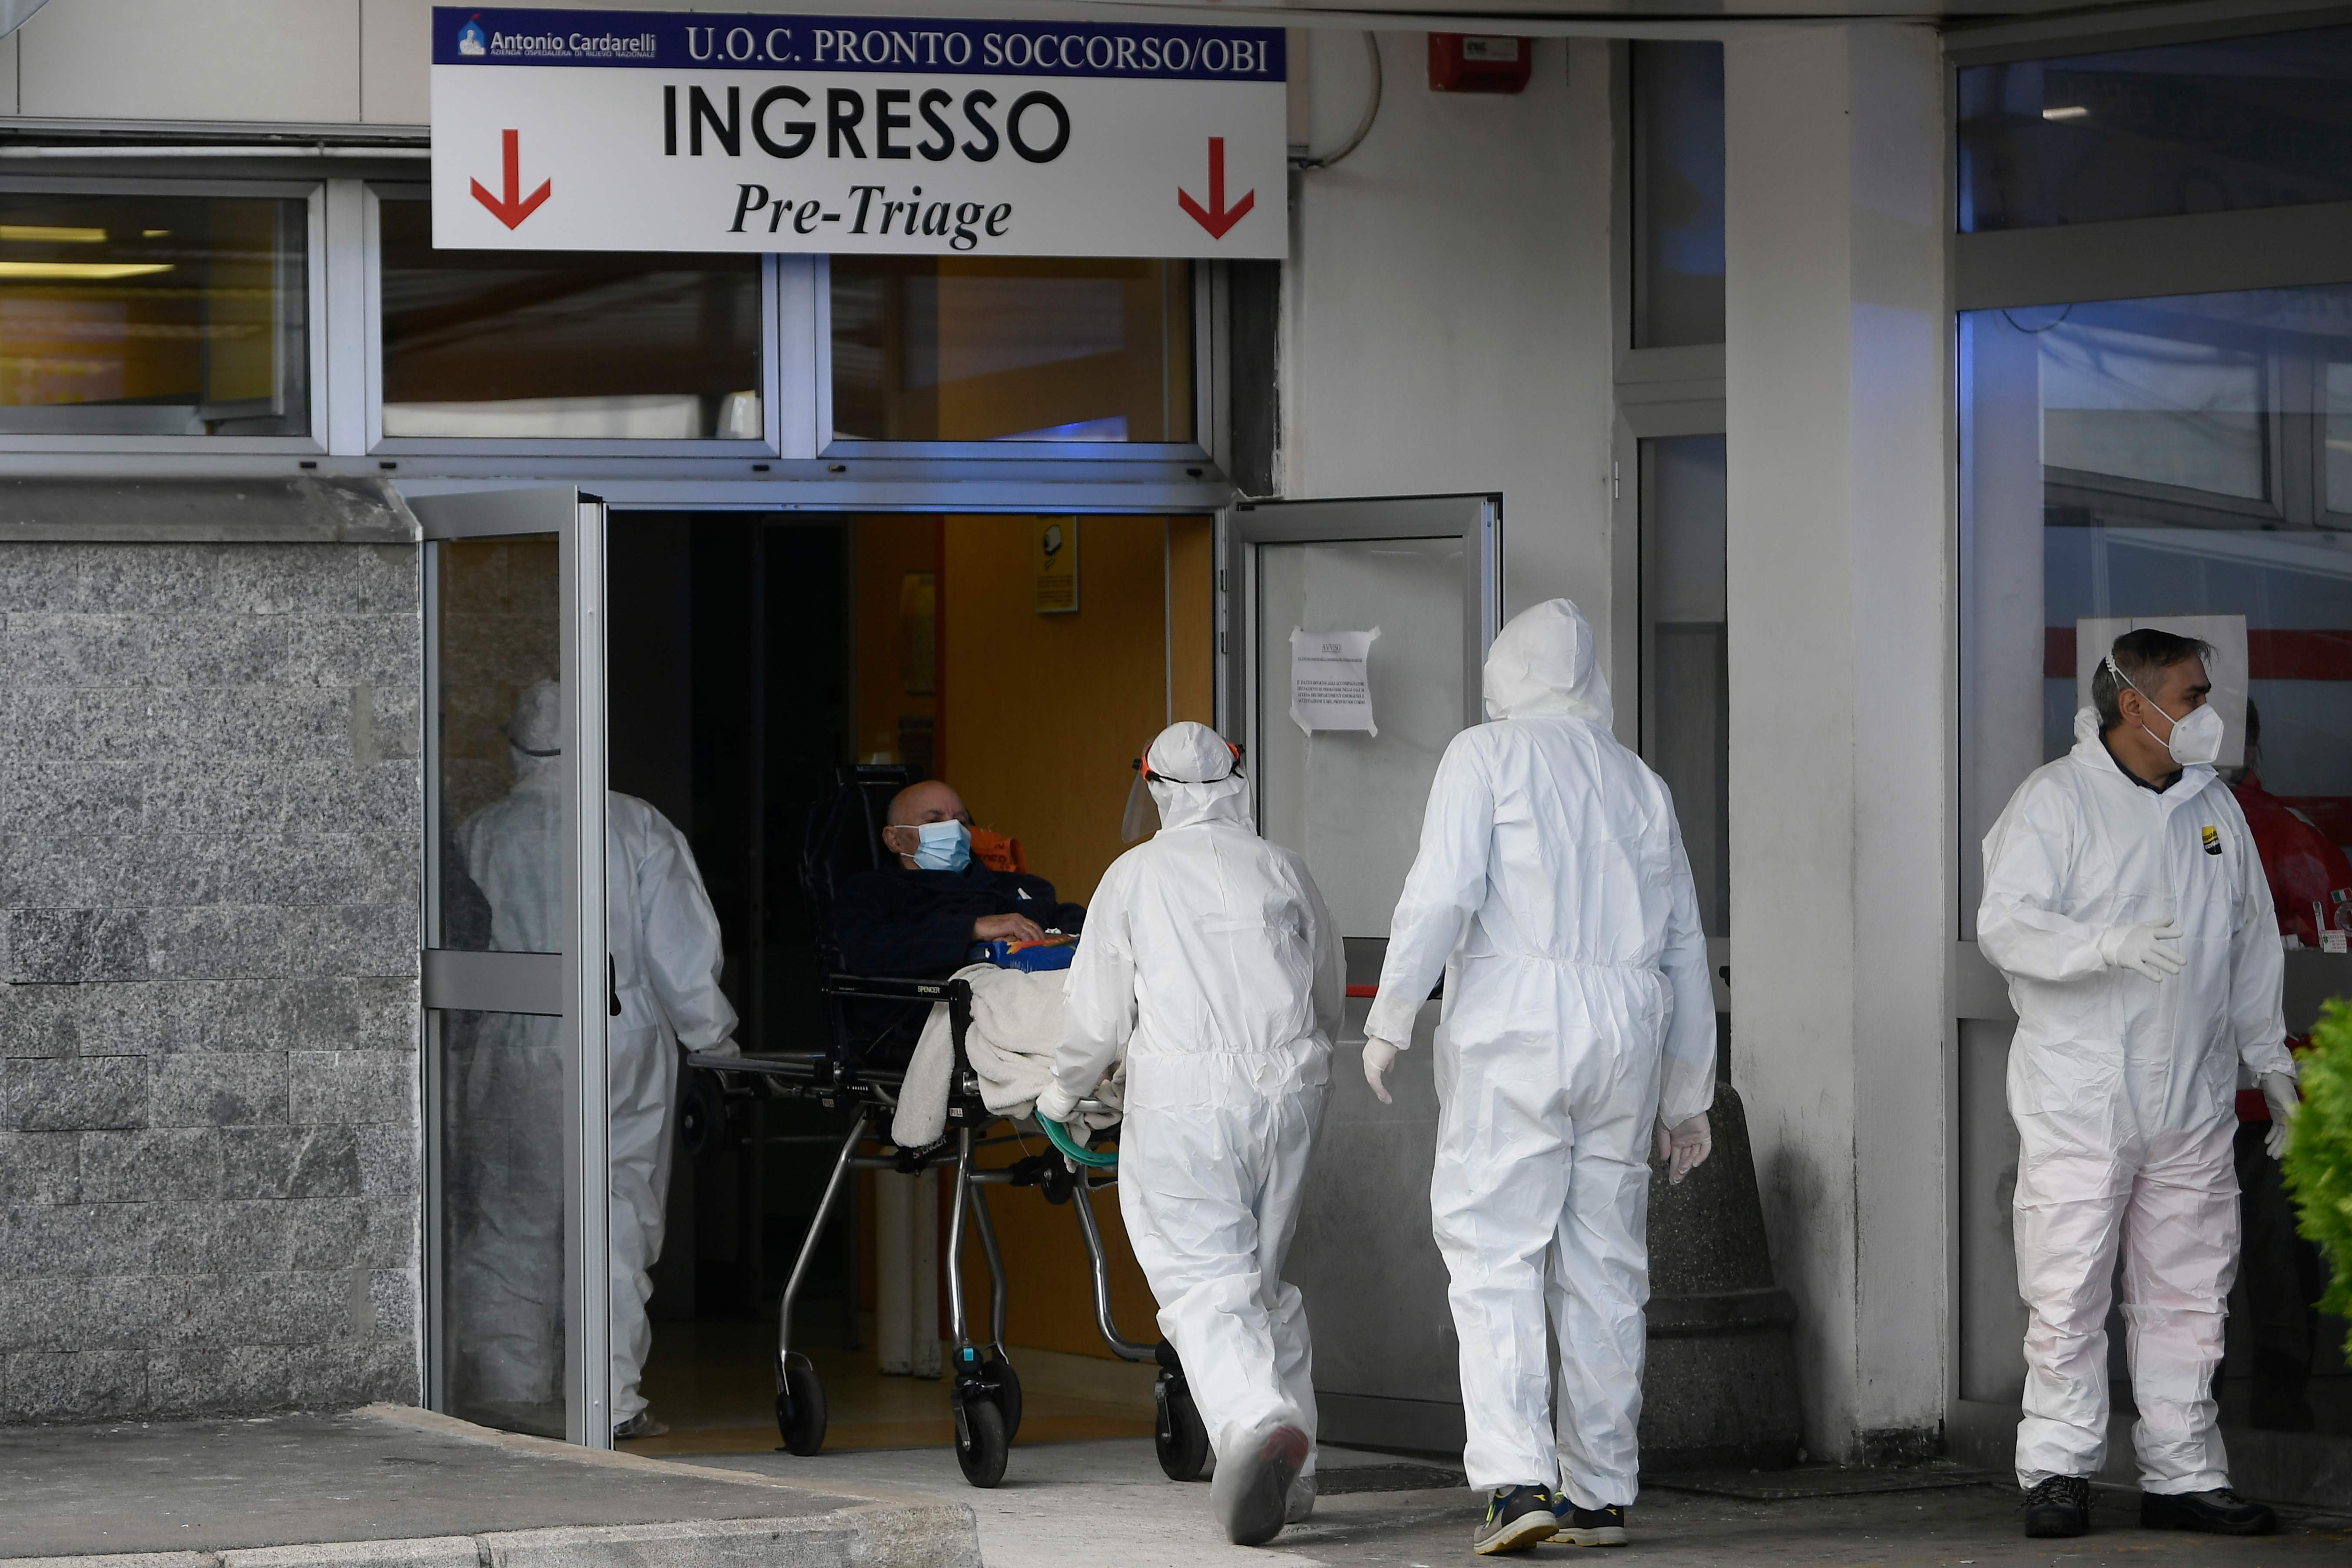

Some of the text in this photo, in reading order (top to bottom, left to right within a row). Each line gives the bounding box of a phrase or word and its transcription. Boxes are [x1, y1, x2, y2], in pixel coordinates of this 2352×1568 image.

[491, 31, 655, 51] Antonio Cardarelli
[685, 27, 1268, 72] U.O.C. PRONTO SOCCORSO/OBI
[663, 84, 1070, 163] INGRESSO
[726, 183, 1012, 251] Pre-Triage
[918, 985, 940, 994] SPENCER
